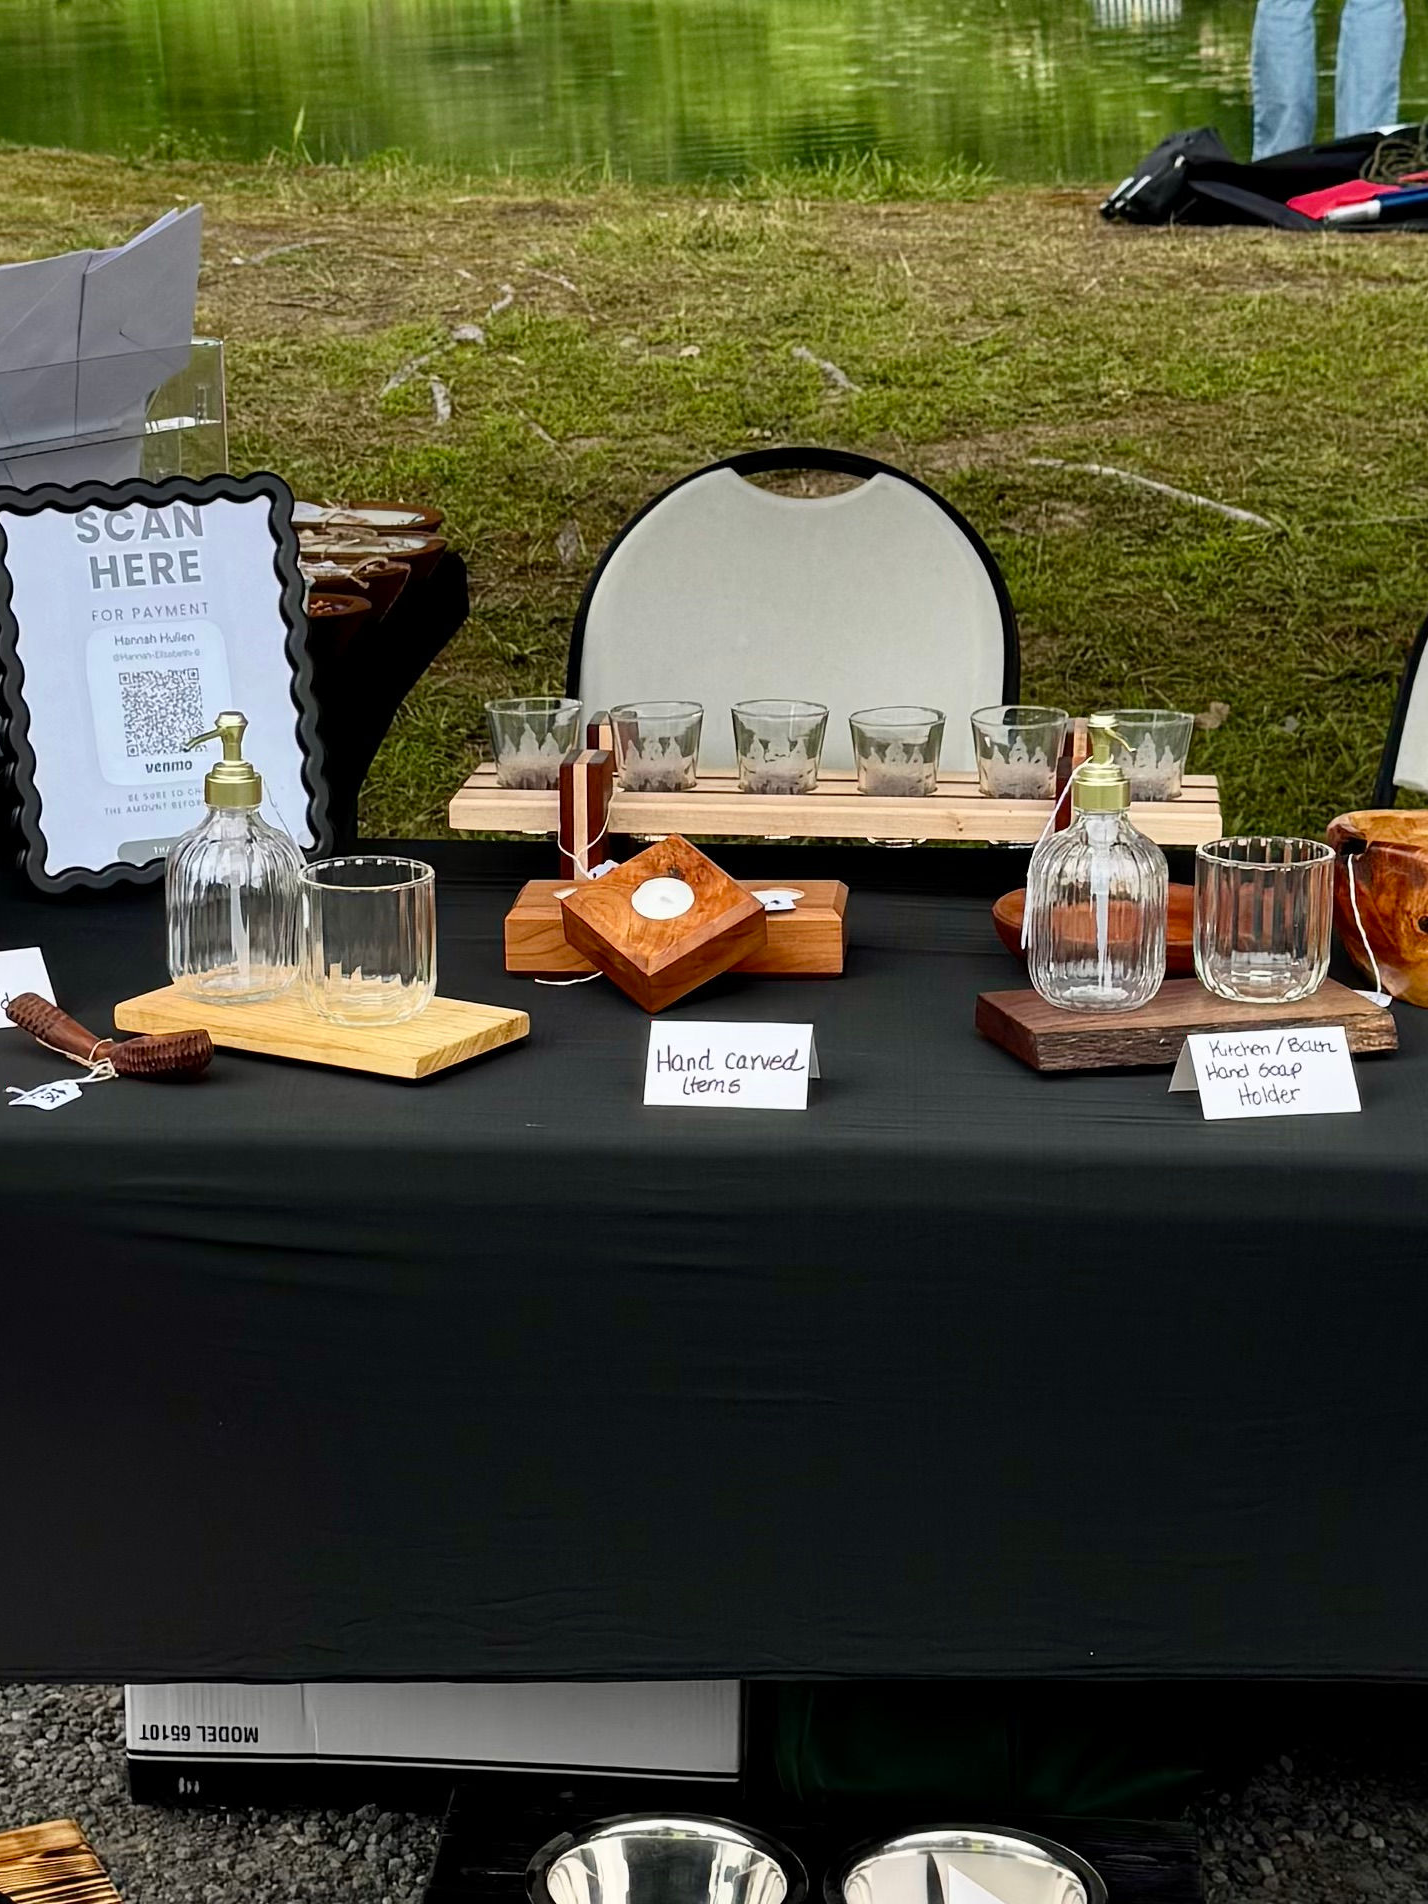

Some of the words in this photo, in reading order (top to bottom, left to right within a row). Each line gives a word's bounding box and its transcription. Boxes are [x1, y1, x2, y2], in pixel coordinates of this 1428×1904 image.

[74, 505, 205, 544] SCAN
[88, 549, 202, 590] HERE
[91, 608, 124, 622] FOR
[132, 602, 209, 621] PAYMENT
[114, 634, 157, 646] Hannah
[145, 760, 193, 774] venmo
[656, 1044, 714, 1073] Hand
[1205, 1061, 1249, 1081] Hand
[1238, 1082, 1301, 1106] Holder
[195, 1725, 259, 1744] MODEL
